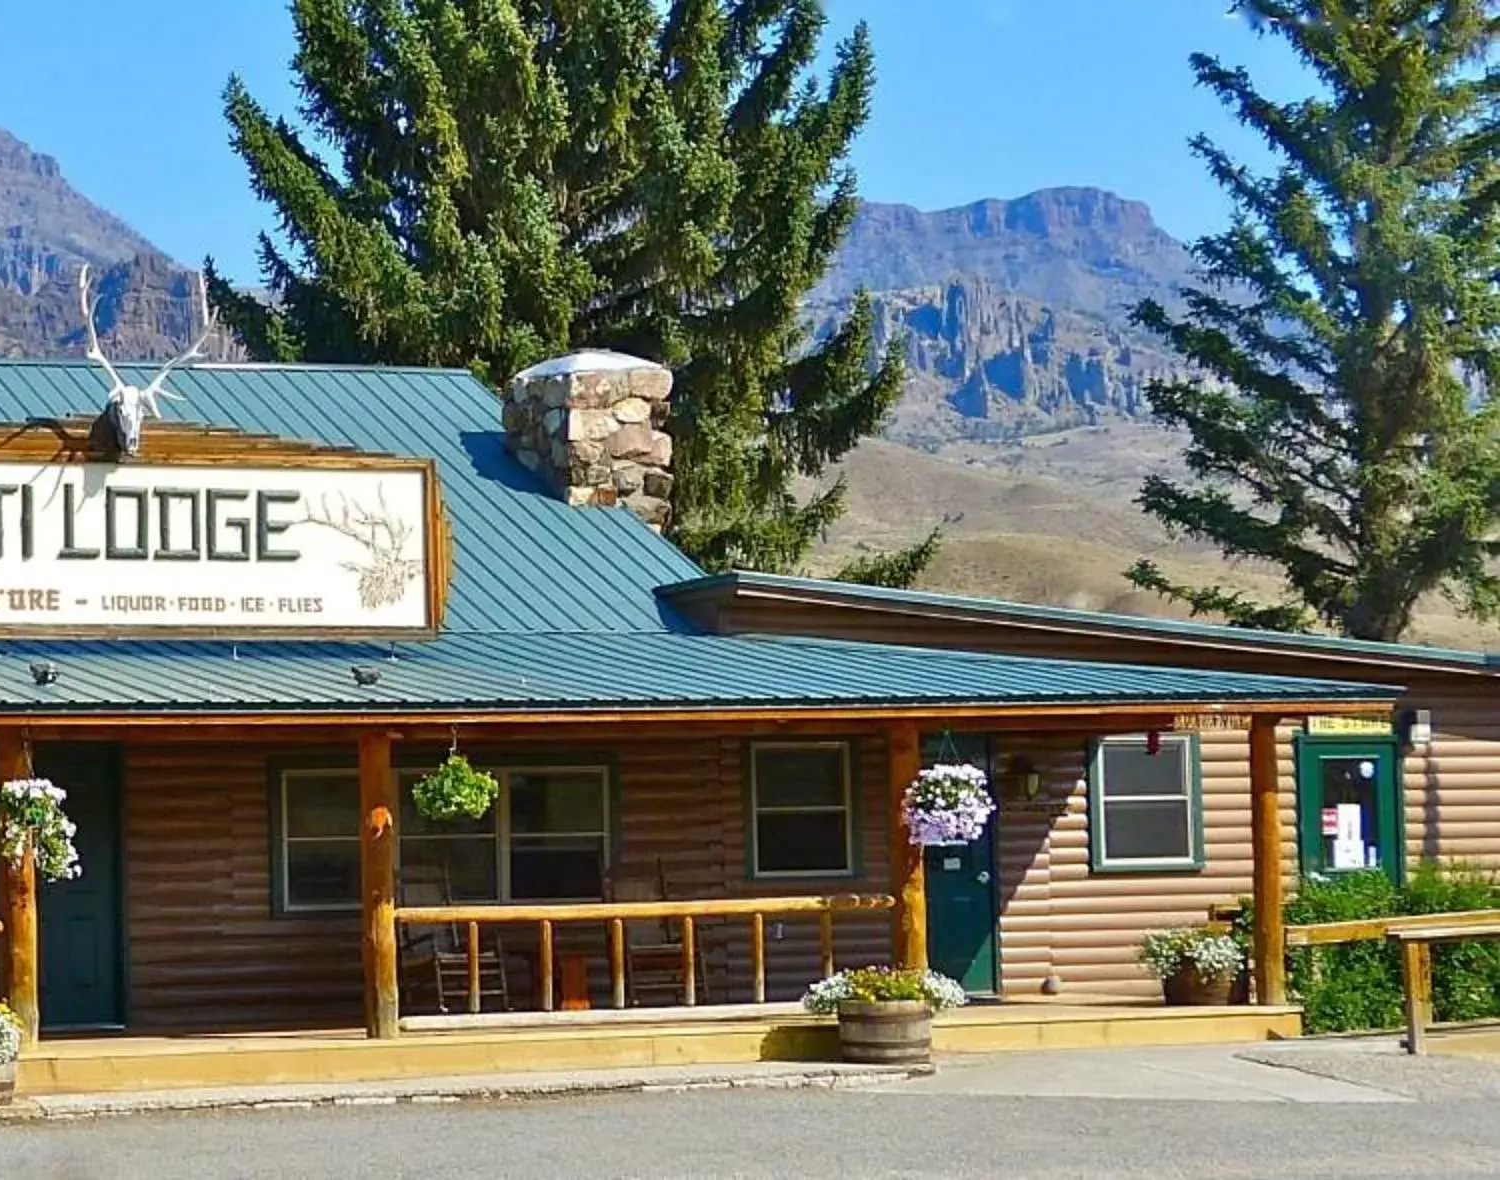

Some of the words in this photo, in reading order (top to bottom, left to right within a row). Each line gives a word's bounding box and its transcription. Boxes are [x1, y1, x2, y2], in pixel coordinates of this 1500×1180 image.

[57, 483, 301, 563] LODGE
[101, 595, 166, 613] LIQUOR
[177, 596, 226, 613] FOOD
[240, 596, 265, 613] ICE
[278, 597, 323, 613] FLIES
